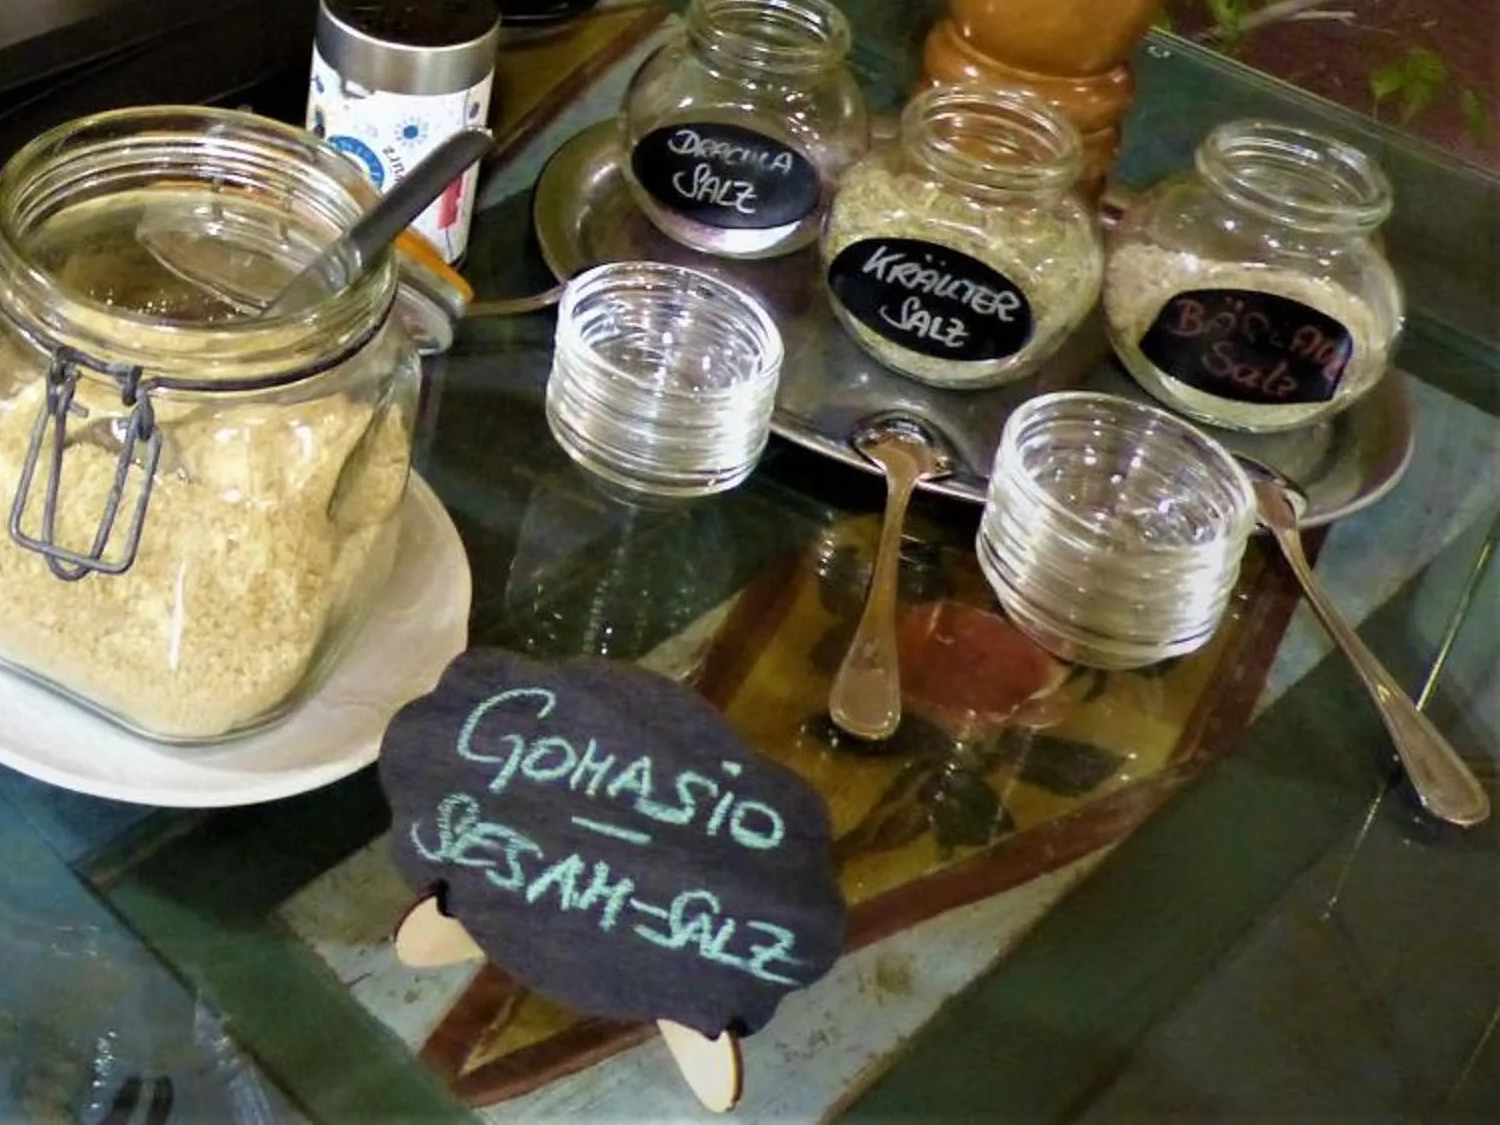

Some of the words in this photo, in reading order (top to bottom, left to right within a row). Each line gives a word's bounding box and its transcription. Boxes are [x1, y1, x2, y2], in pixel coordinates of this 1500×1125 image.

[672, 162, 757, 213] SALZ
[862, 245, 1021, 322] KRÄUTER
[878, 296, 970, 347] SALZ
